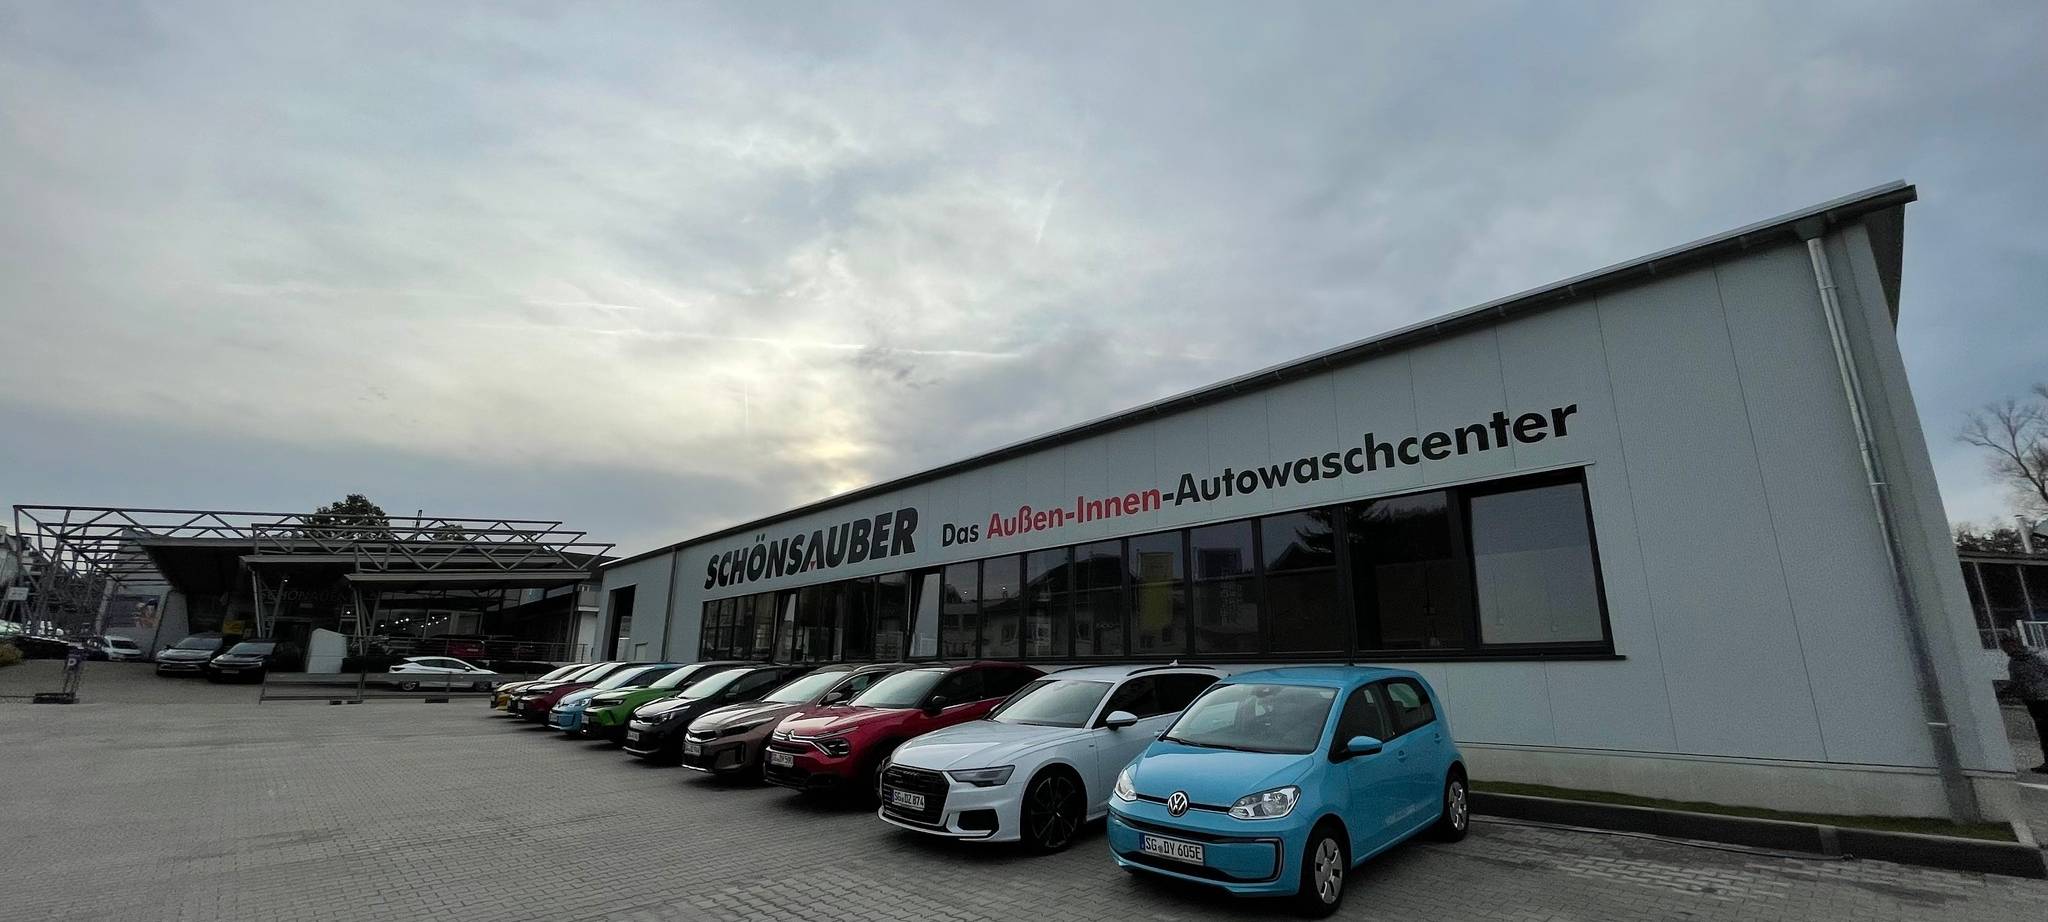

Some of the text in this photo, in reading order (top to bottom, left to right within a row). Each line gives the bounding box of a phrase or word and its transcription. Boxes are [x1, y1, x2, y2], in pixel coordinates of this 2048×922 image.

[704, 507, 919, 590] SCHÖNSAUBER
[942, 522, 979, 547] Das
[1145, 837, 1202, 860] SG DY 605E
